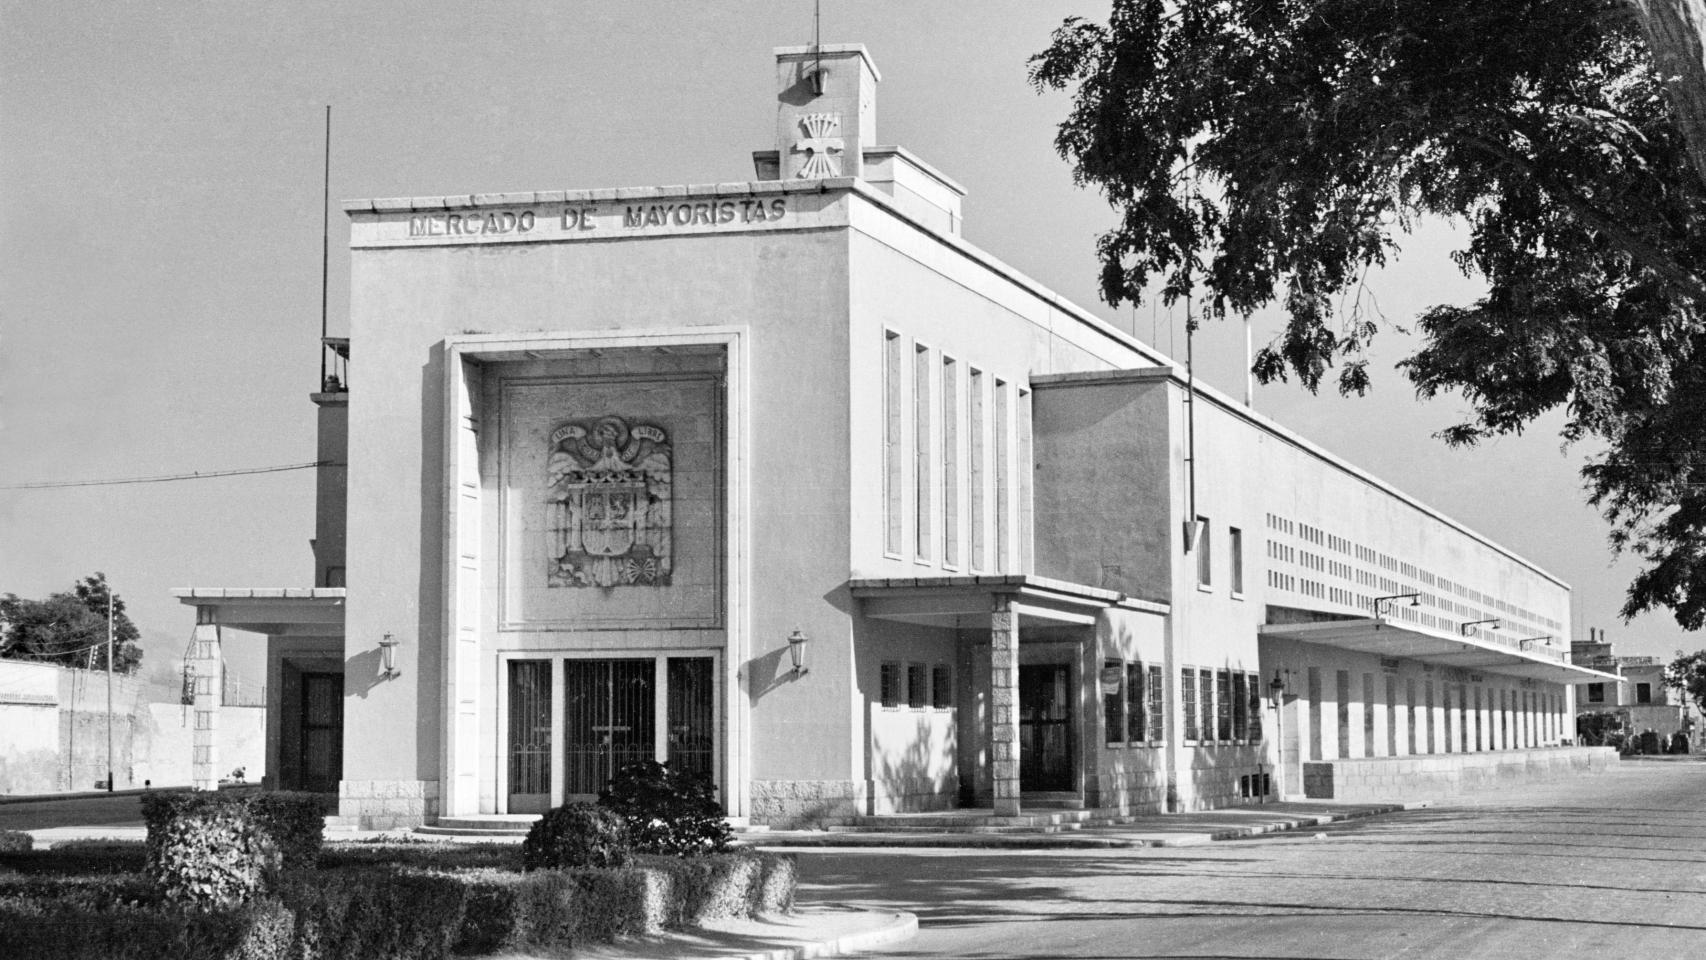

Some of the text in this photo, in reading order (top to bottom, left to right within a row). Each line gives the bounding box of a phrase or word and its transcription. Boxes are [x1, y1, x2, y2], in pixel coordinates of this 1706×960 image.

[409, 199, 787, 237] MERCADO DE MAYORISTAS
